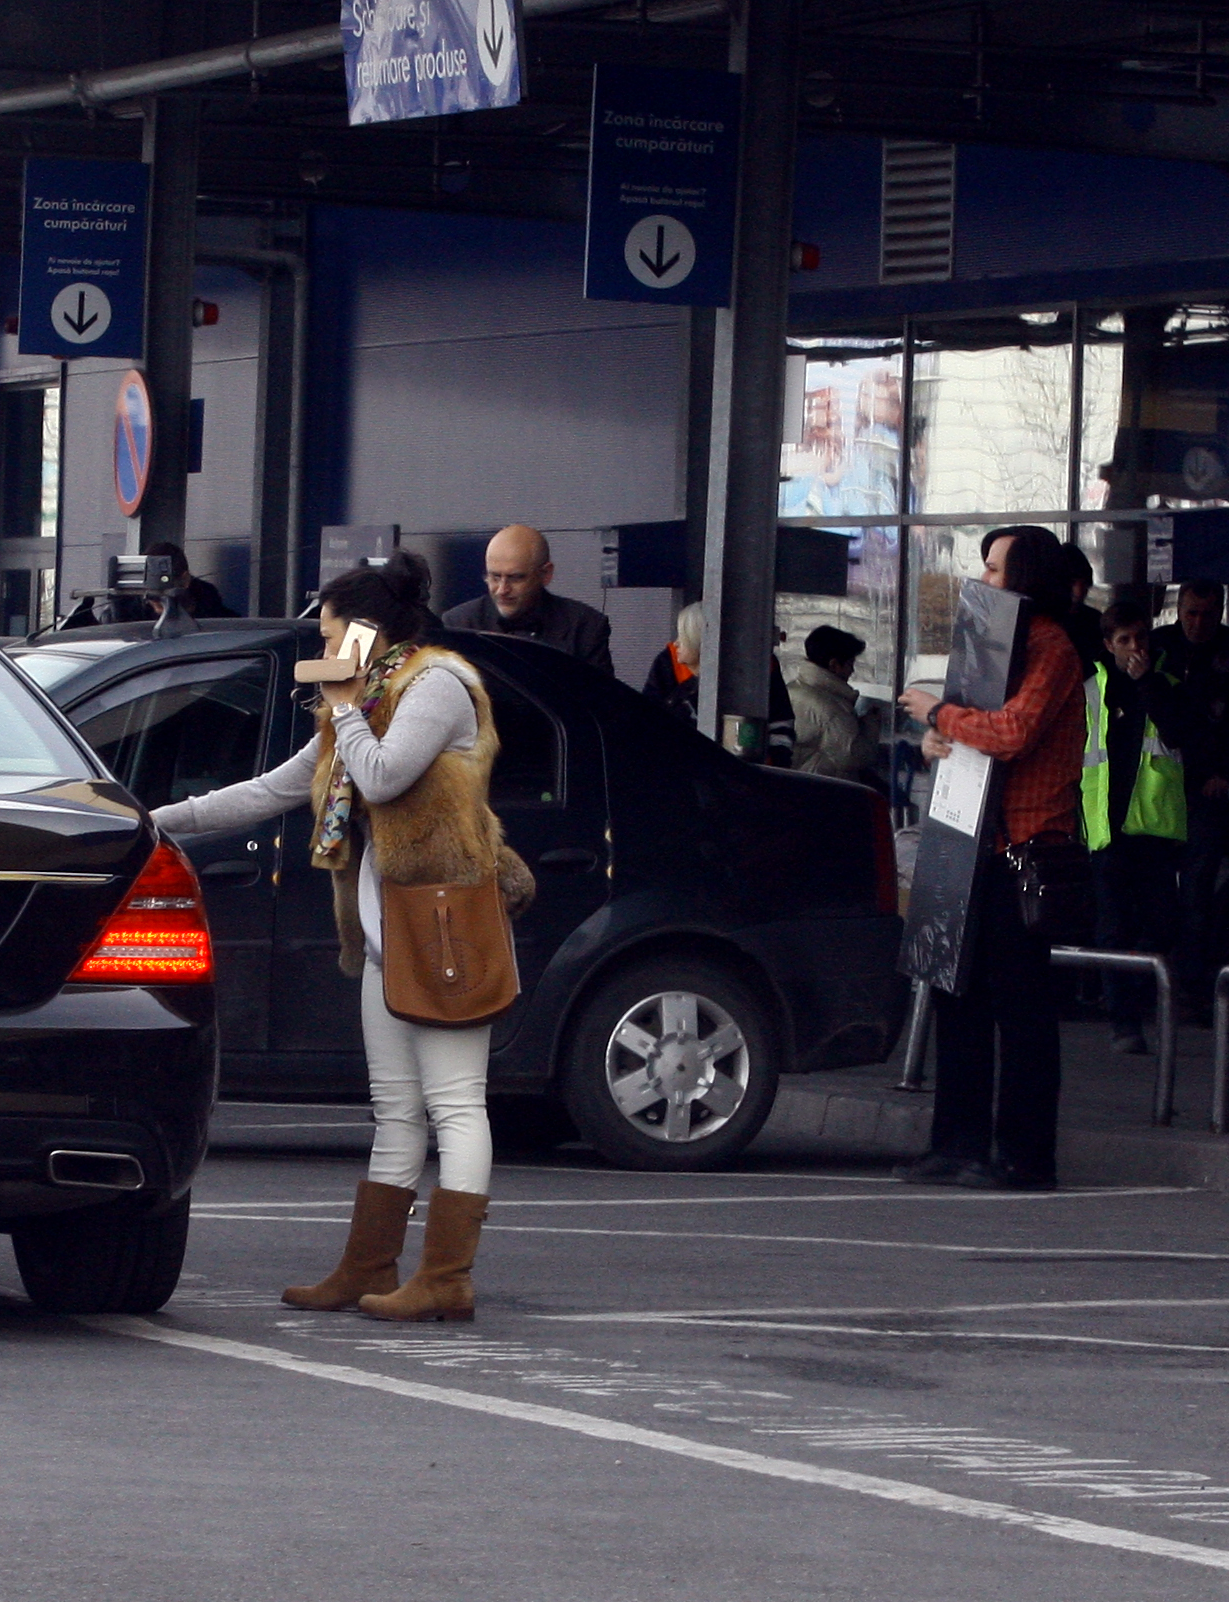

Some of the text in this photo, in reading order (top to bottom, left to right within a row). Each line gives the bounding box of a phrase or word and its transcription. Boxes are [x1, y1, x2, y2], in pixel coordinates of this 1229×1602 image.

[414, 38, 468, 93] produse
[615, 136, 714, 154] cumpărături
[32, 196, 136, 214] Zonă încărcare
[43, 217, 127, 232] cumpărături
